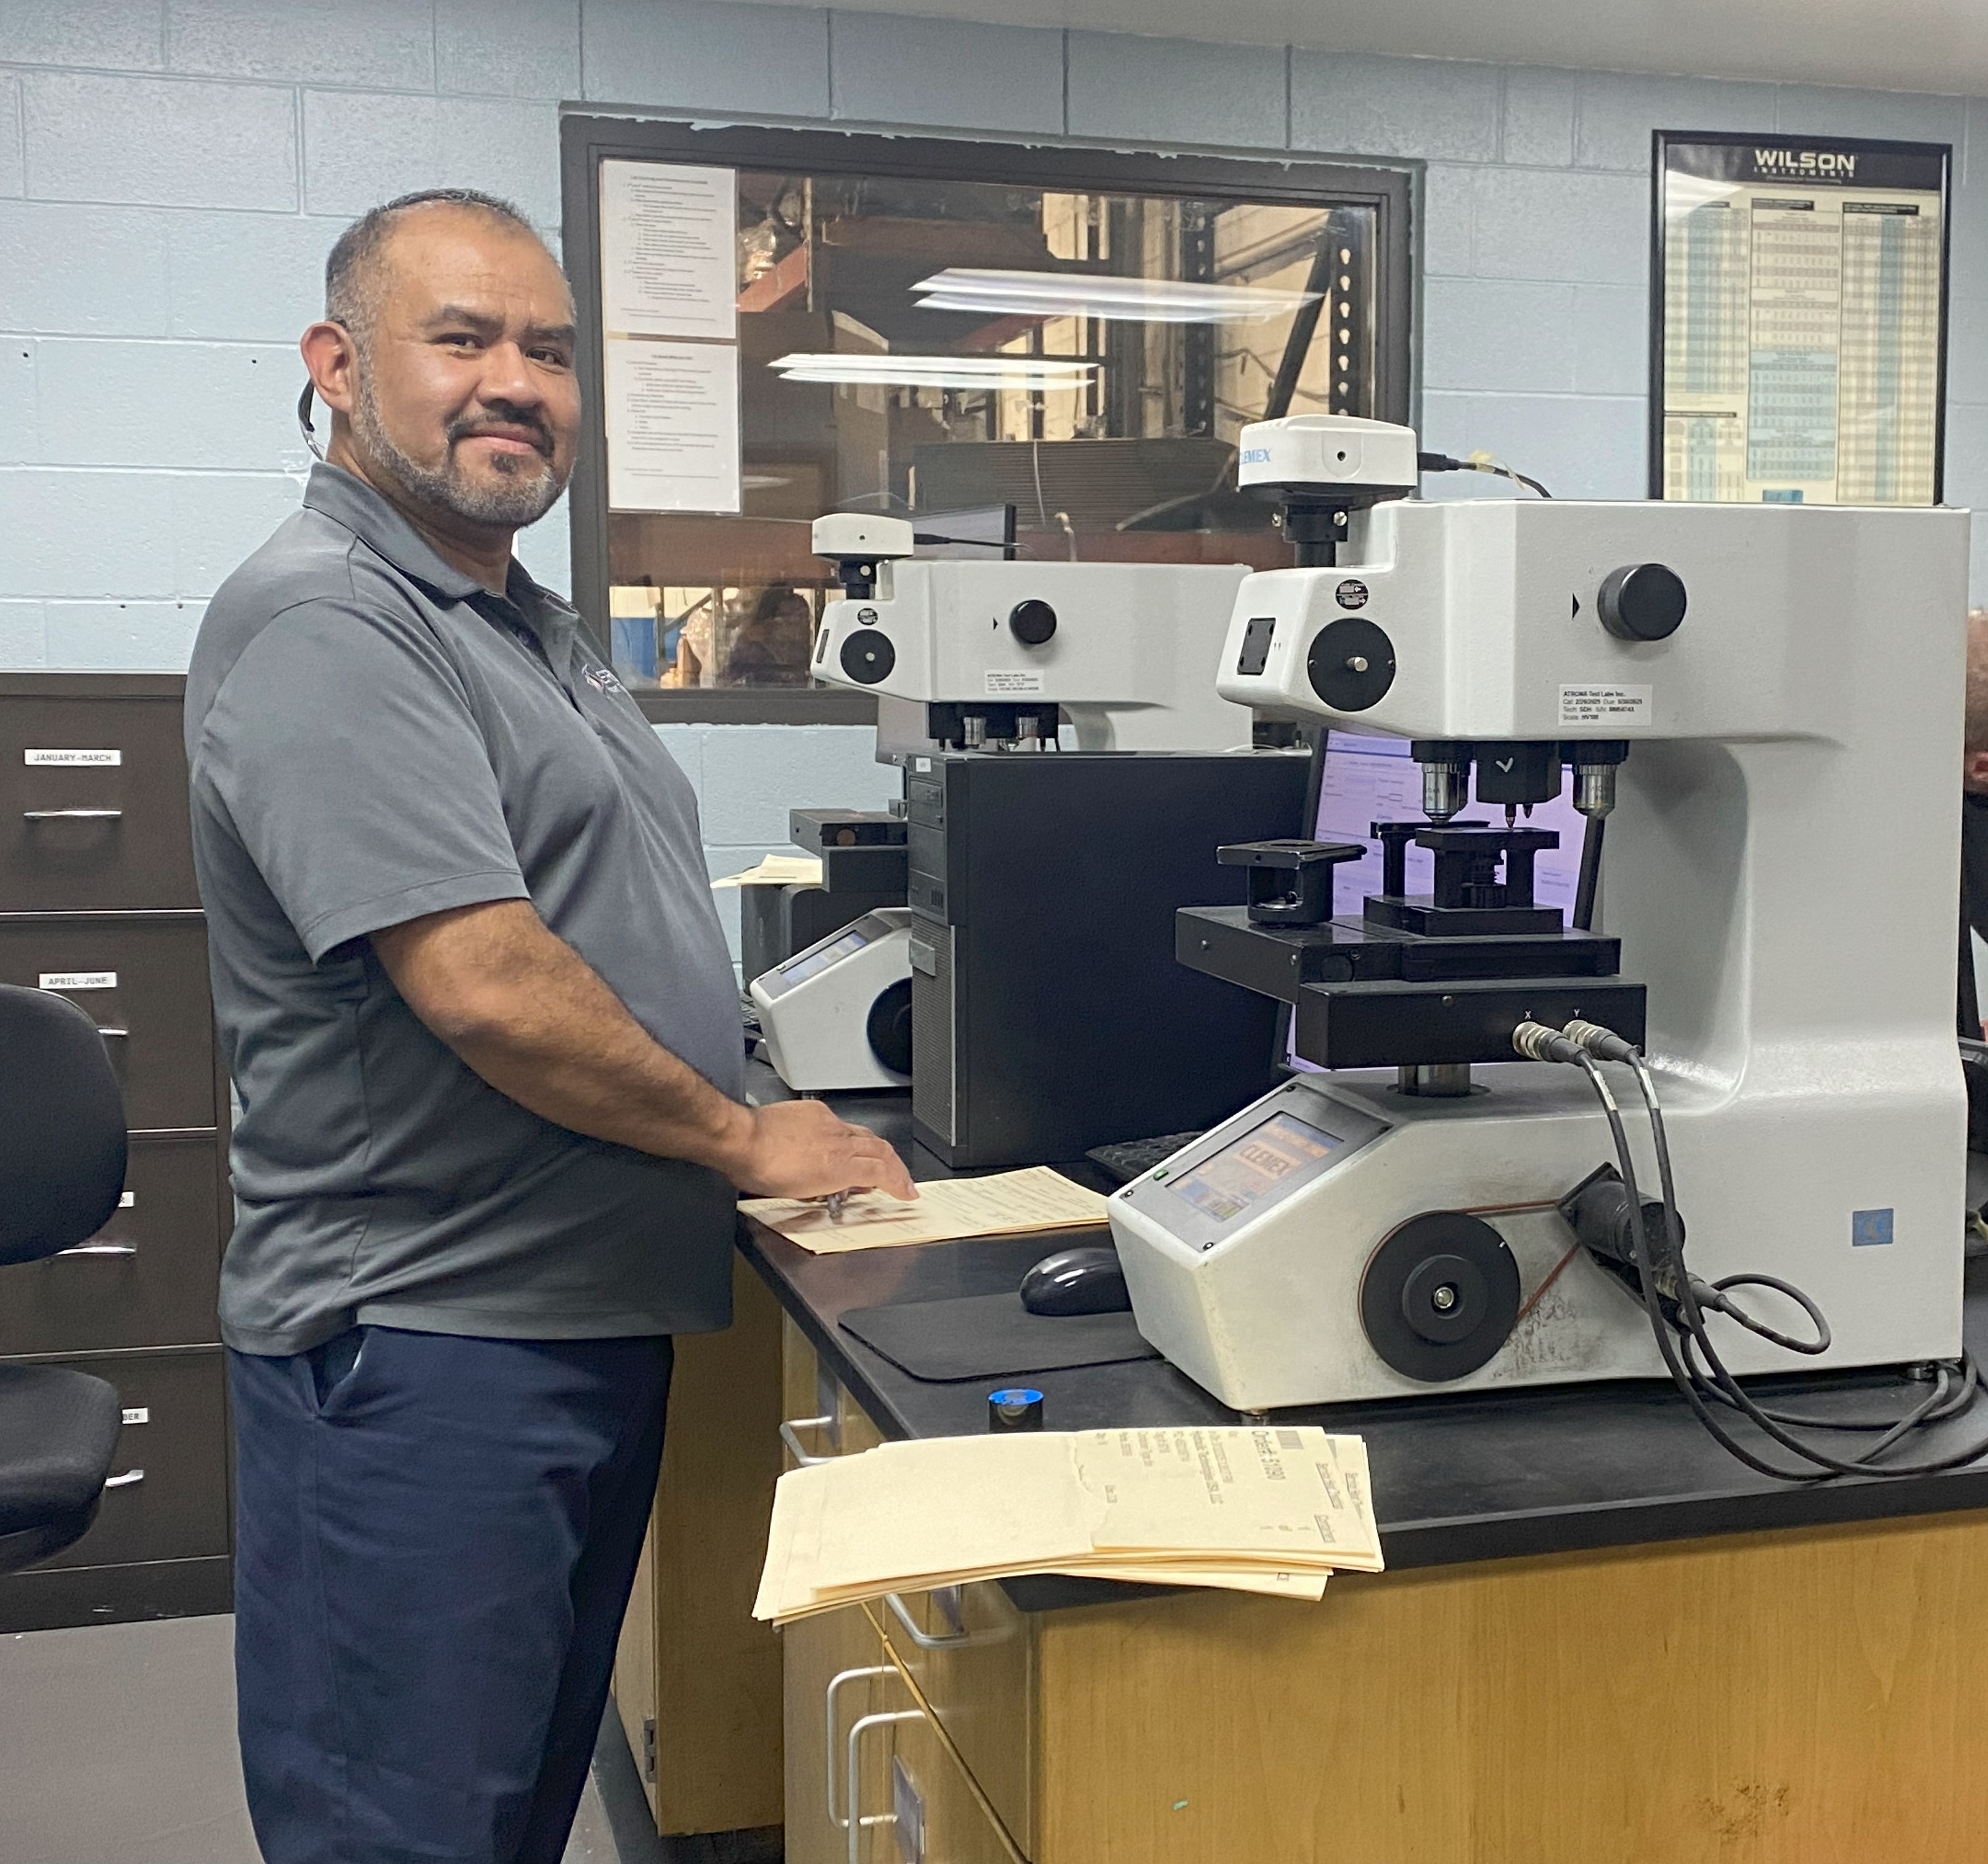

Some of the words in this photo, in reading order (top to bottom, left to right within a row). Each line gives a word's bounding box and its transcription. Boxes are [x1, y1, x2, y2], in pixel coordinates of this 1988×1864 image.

[1755, 149, 1855, 171] WILSON
[1753, 166, 1854, 178] INSTRUMENTS
[1240, 448, 1272, 465] LEMEX
[34, 753, 112, 762] JANUARY-MARCH
[47, 976, 108, 985] APRIL-JUNE
[1524, 1010, 1532, 1020] X
[1573, 1008, 1581, 1018] Y
